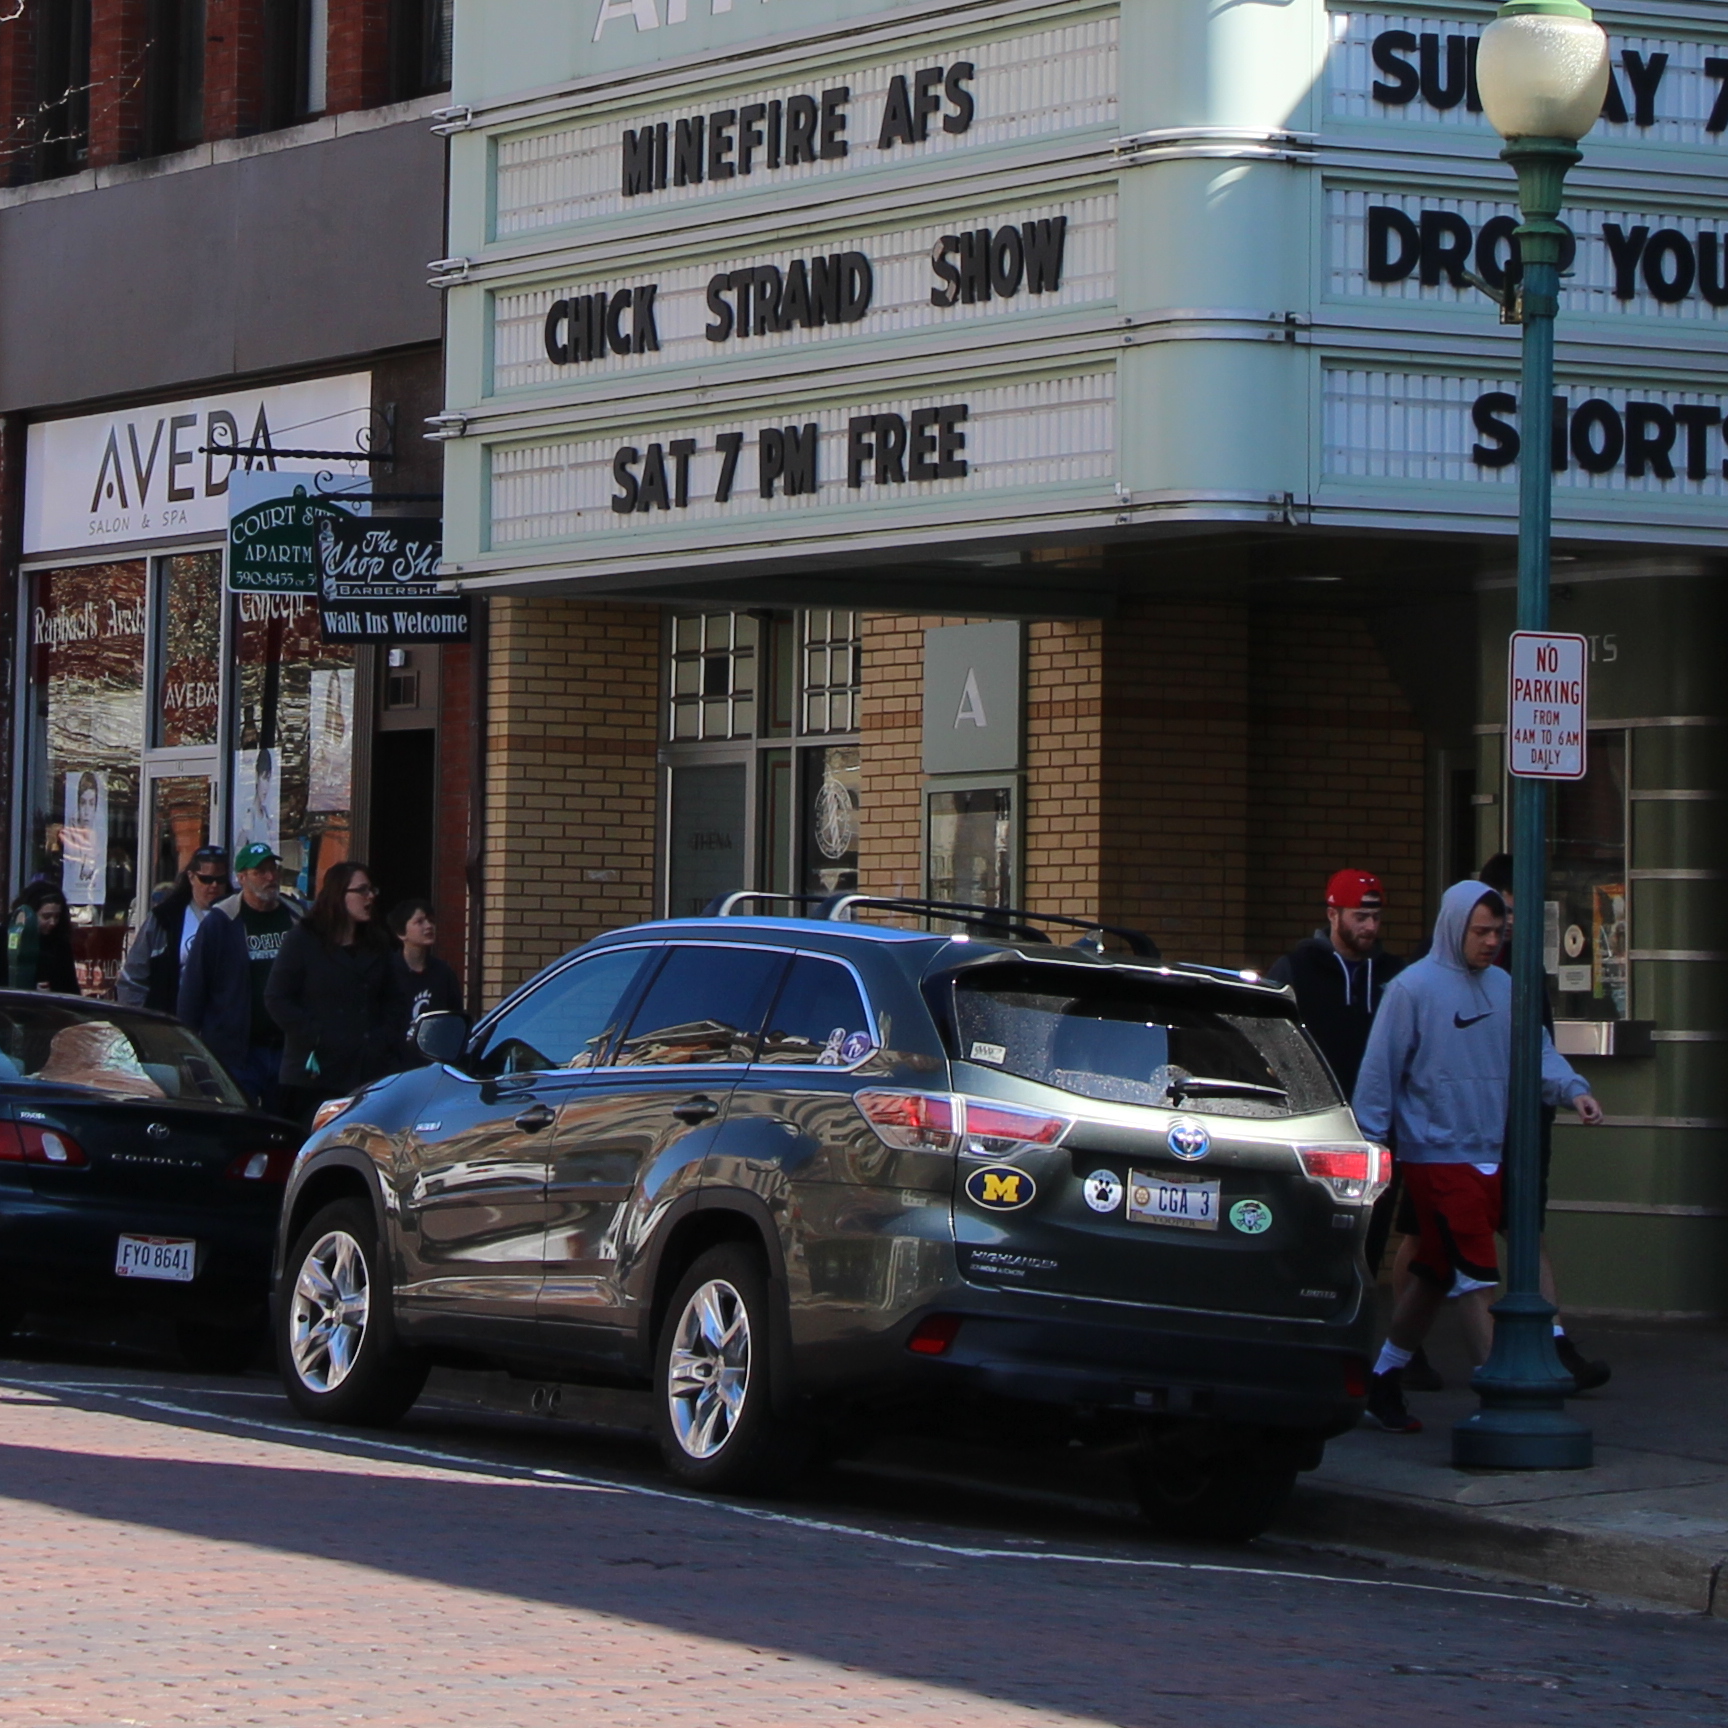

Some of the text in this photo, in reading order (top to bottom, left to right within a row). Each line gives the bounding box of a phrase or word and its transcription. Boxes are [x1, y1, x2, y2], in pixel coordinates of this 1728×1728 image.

[1372, 30, 1669, 127] SUAY
[622, 62, 974, 197] MINEFIRE AFS
[545, 215, 1066, 365] CHICK STRAND SHOW
[90, 401, 277, 513] AVEDA
[611, 403, 968, 514] SAT 7 PM FREE
[88, 508, 189, 536] SALON & SPA
[232, 505, 296, 544] COURT
[245, 544, 312, 563] APARTM
[362, 530, 398, 553] The
[323, 541, 386, 583] Chop
[236, 571, 293, 586] 590-8455
[323, 611, 468, 634] Walk Ins Welcome
[1536, 646, 1559, 674] NO
[164, 682, 219, 709] AVEDA
[953, 667, 987, 729] A
[1514, 678, 1581, 705] PARKING
[1533, 709, 1560, 727] FROM
[1541, 730, 1553, 746] TO
[1531, 748, 1561, 766] DAILY
[111, 1153, 203, 1167] COROLLA
[983, 1174, 1019, 1203] M
[1159, 1186, 1210, 1216] CGA 3
[154, 1248, 188, 1270] 8641
[971, 1250, 1059, 1269] HIGHLANDER
